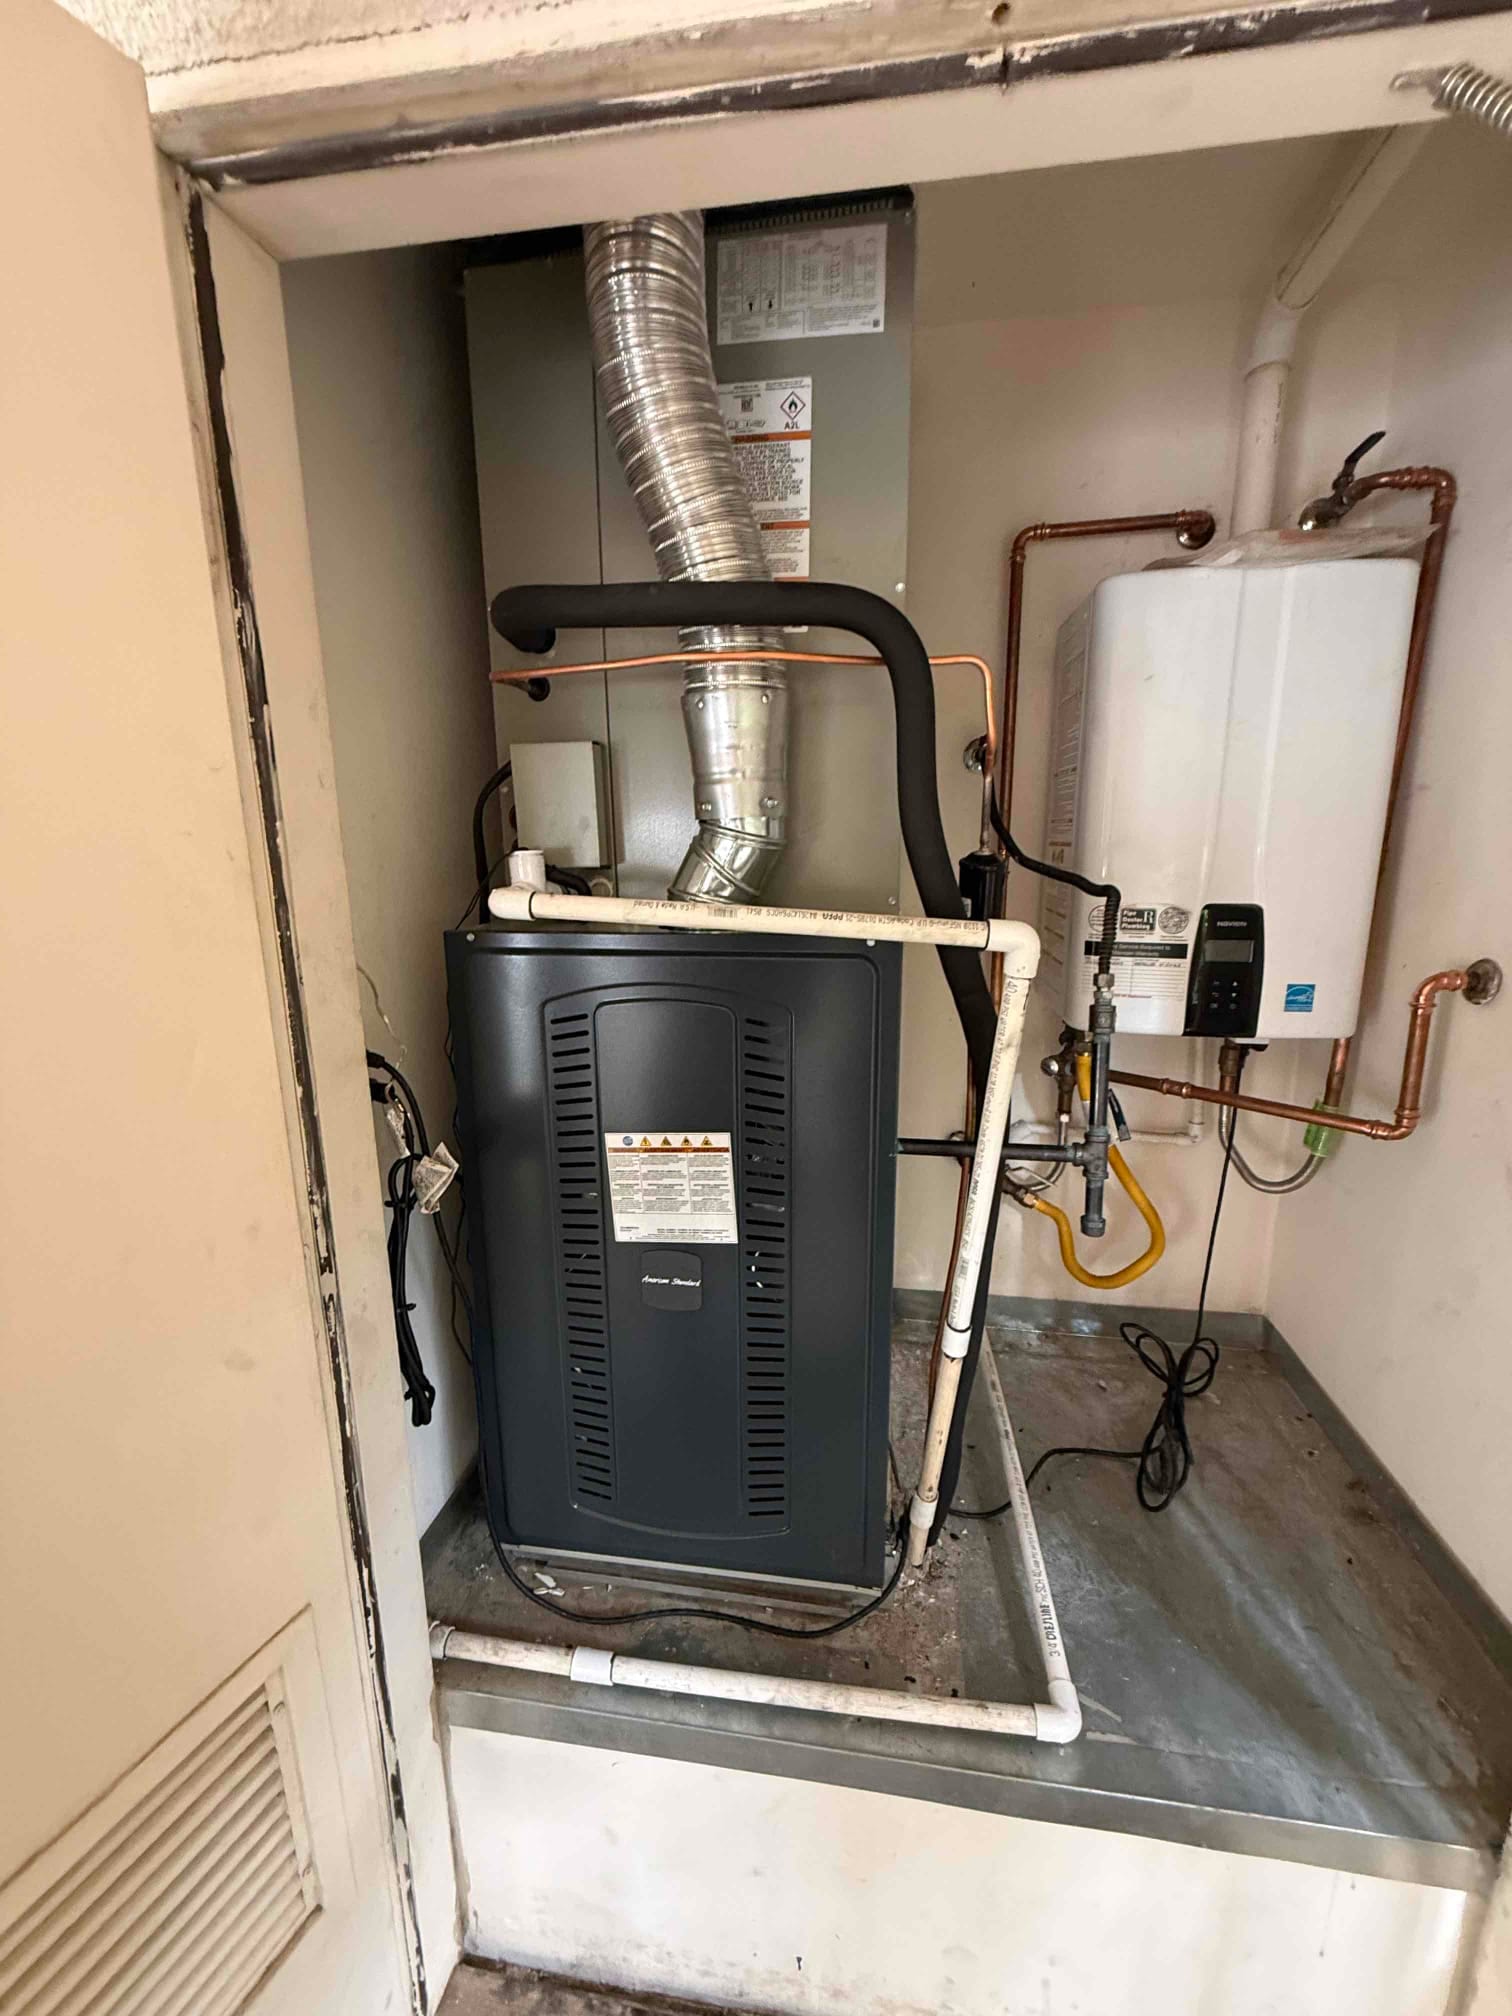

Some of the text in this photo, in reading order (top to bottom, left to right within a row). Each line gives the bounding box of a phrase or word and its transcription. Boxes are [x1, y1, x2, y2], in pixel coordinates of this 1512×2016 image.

[784, 422, 800, 430] A2L
[641, 1274, 702, 1287] American Standard
[1040, 1603, 1057, 1641] CRESLINE
